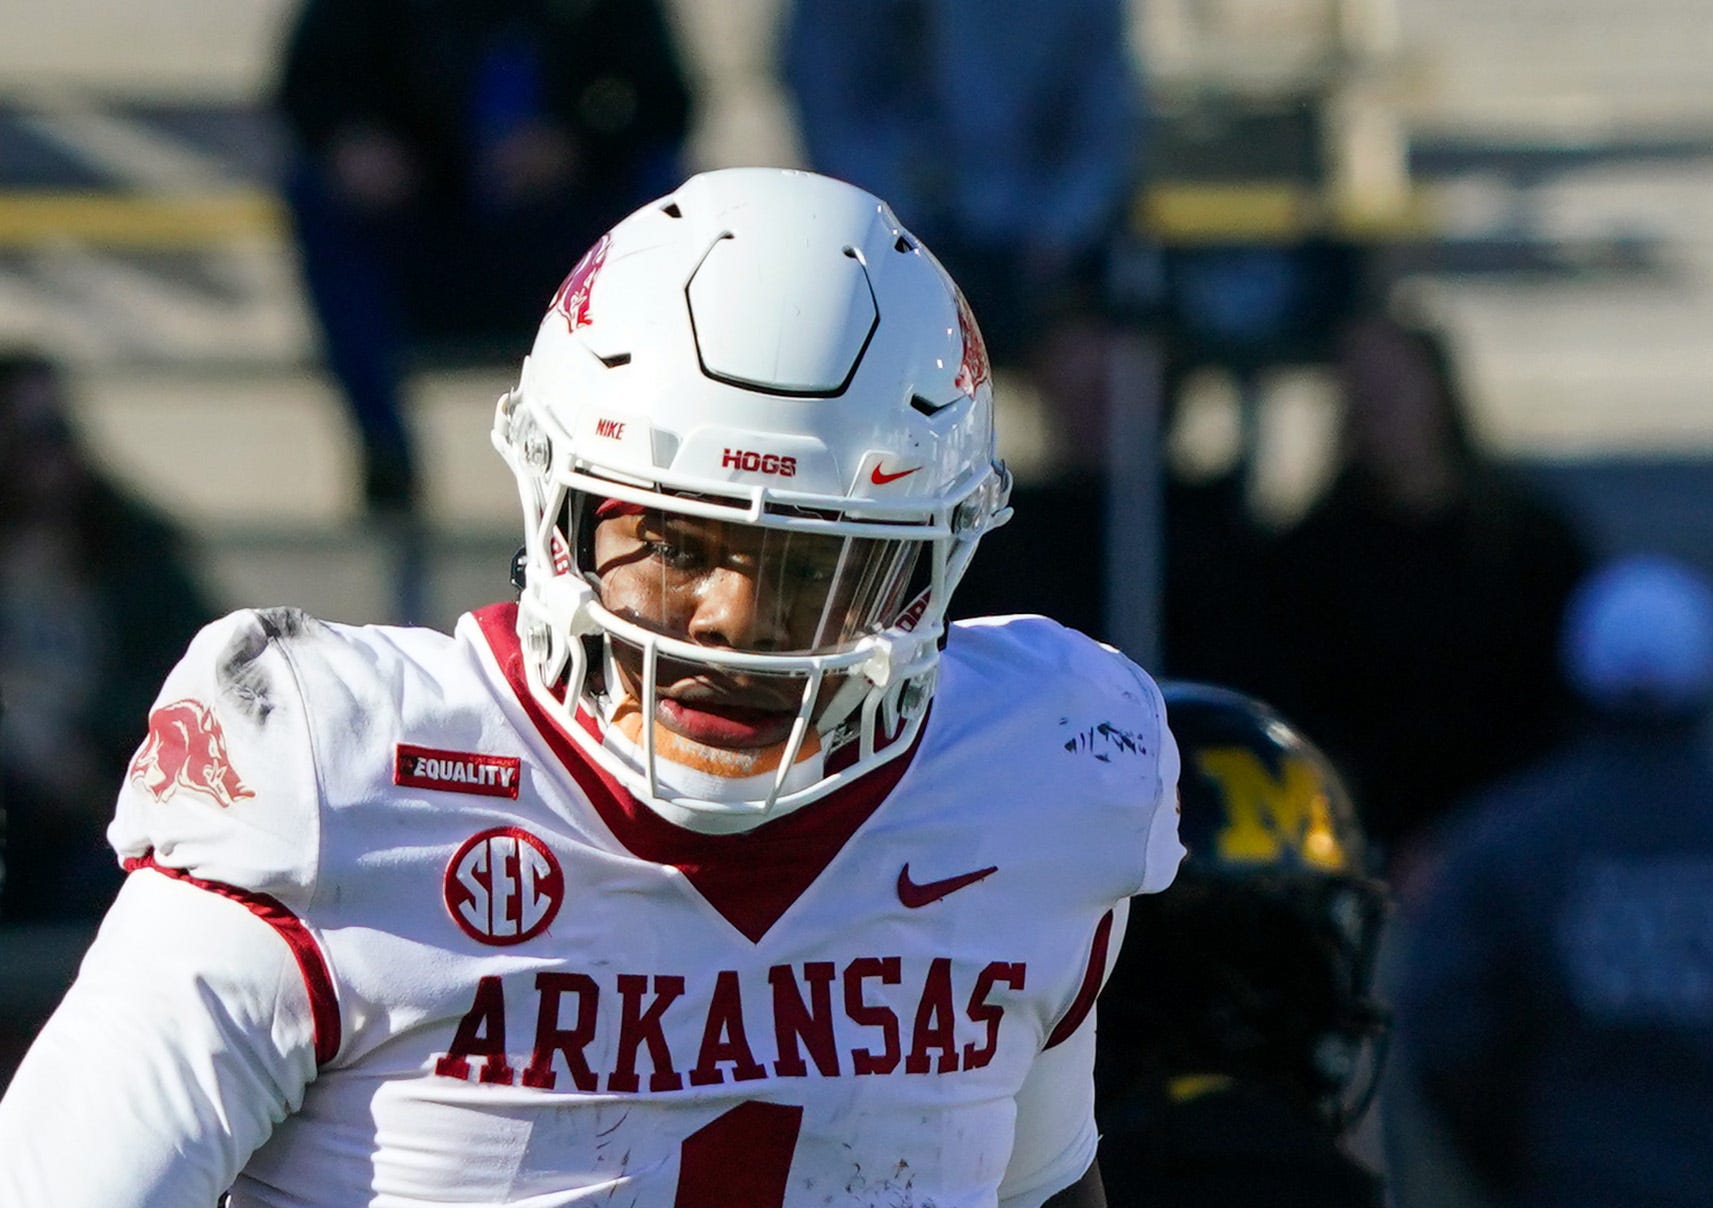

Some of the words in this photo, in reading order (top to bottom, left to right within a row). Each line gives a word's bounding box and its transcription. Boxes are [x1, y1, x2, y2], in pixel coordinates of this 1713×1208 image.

[595, 418, 626, 441] NIKE
[721, 447, 797, 477] HOGS
[413, 757, 515, 788] EQUALITY
[1197, 746, 1346, 872] M
[455, 836, 552, 937] SEC
[434, 956, 1026, 1092] ARKANSAS
